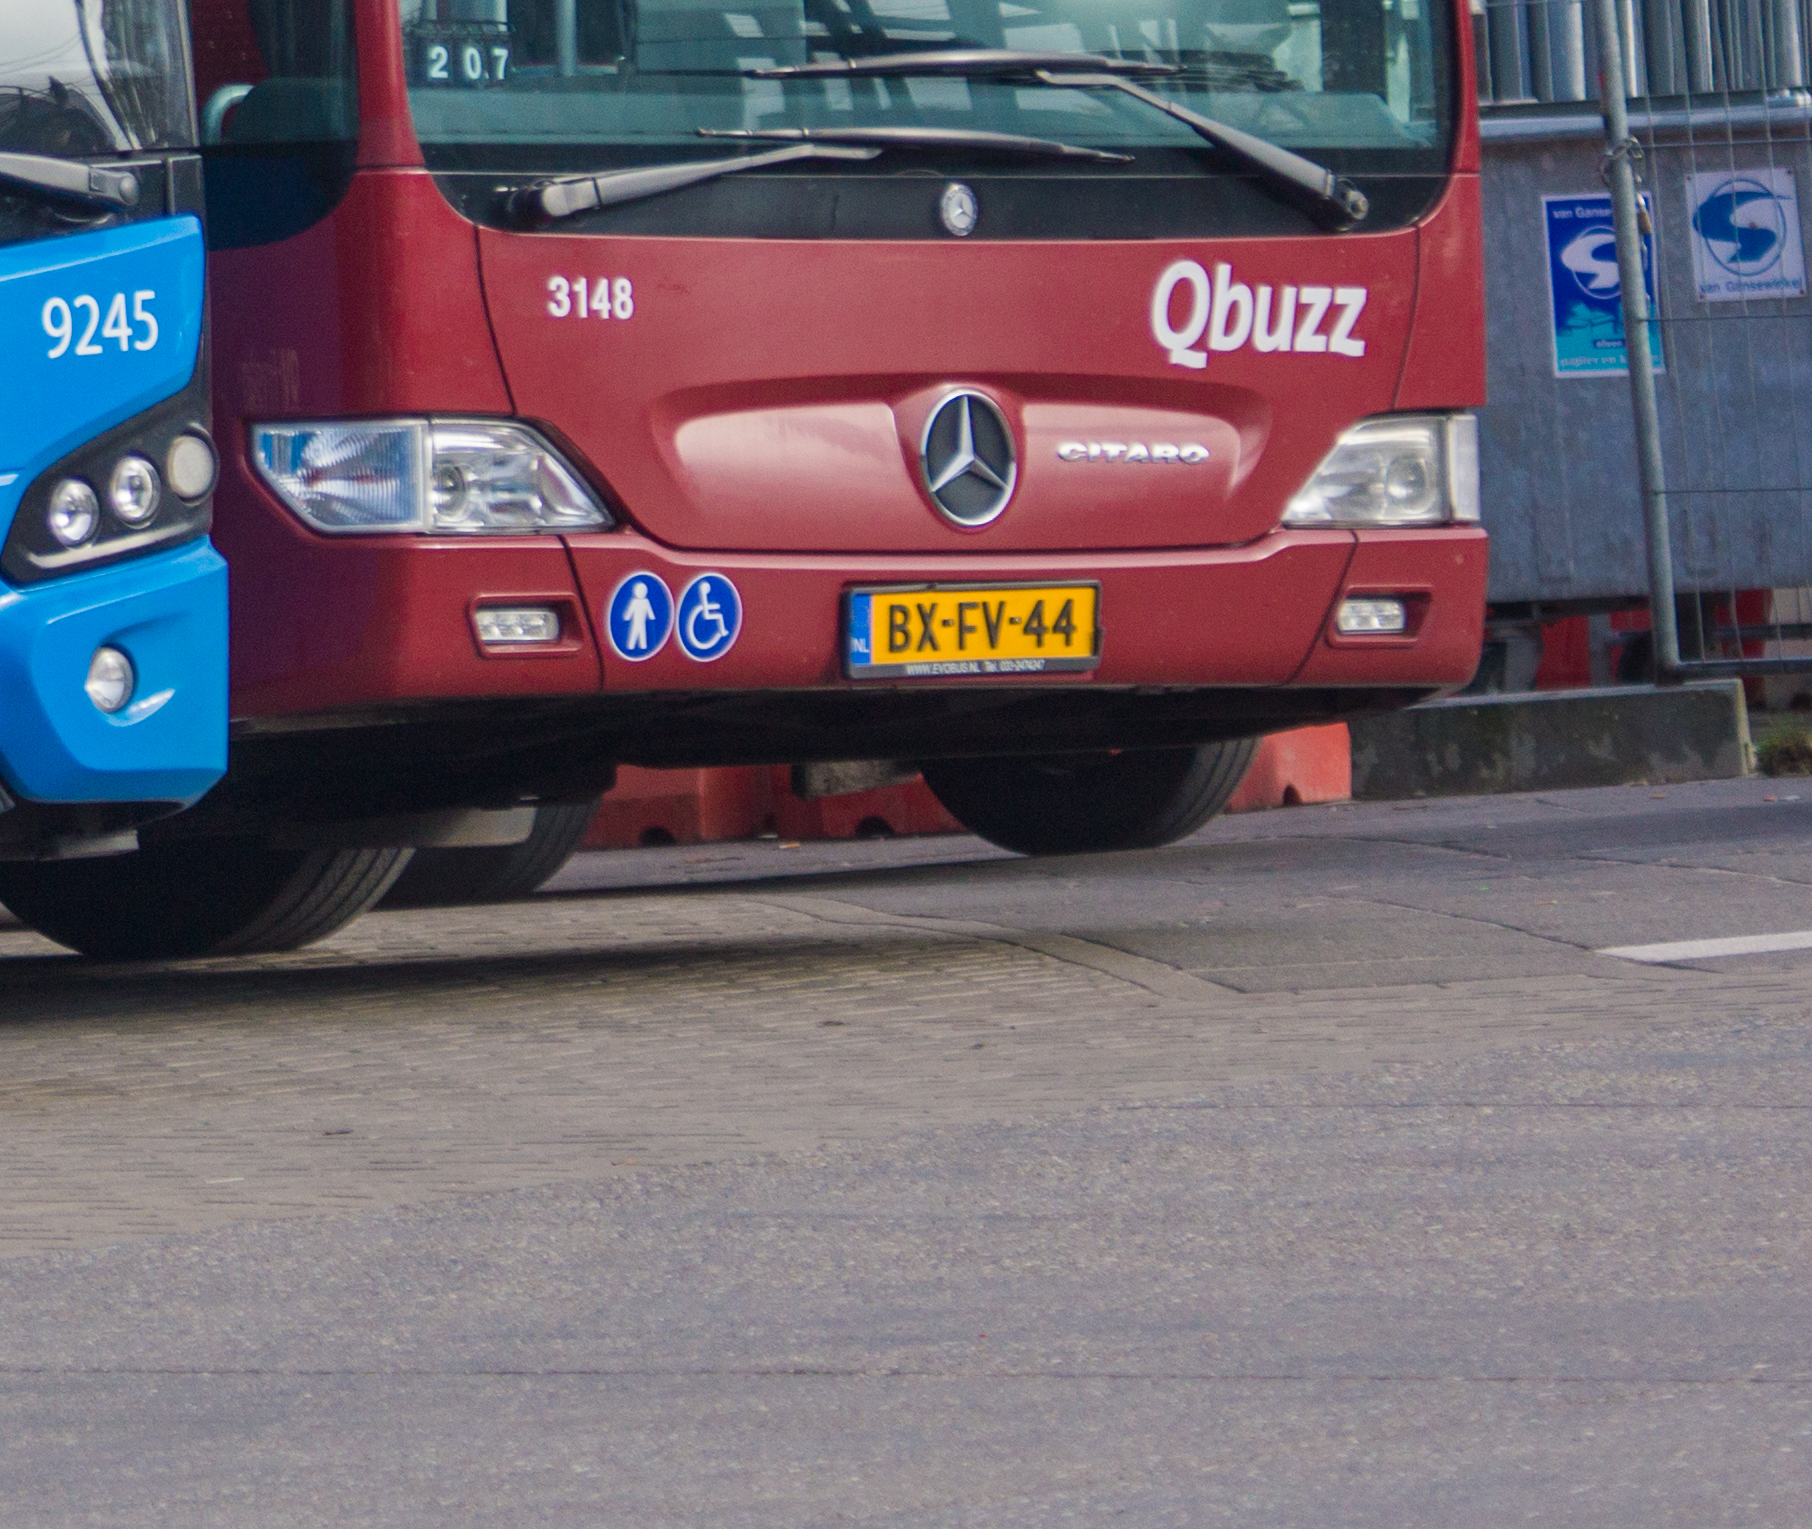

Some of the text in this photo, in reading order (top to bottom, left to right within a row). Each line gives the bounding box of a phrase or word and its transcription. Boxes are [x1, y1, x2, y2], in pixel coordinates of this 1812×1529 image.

[428, 45, 509, 80] 207
[546, 274, 635, 321] 3148
[1150, 258, 1367, 369] Qbuzz
[42, 290, 159, 359] 9245
[1056, 440, 1210, 465] CITARO
[888, 598, 1077, 654] BX-FV-44
